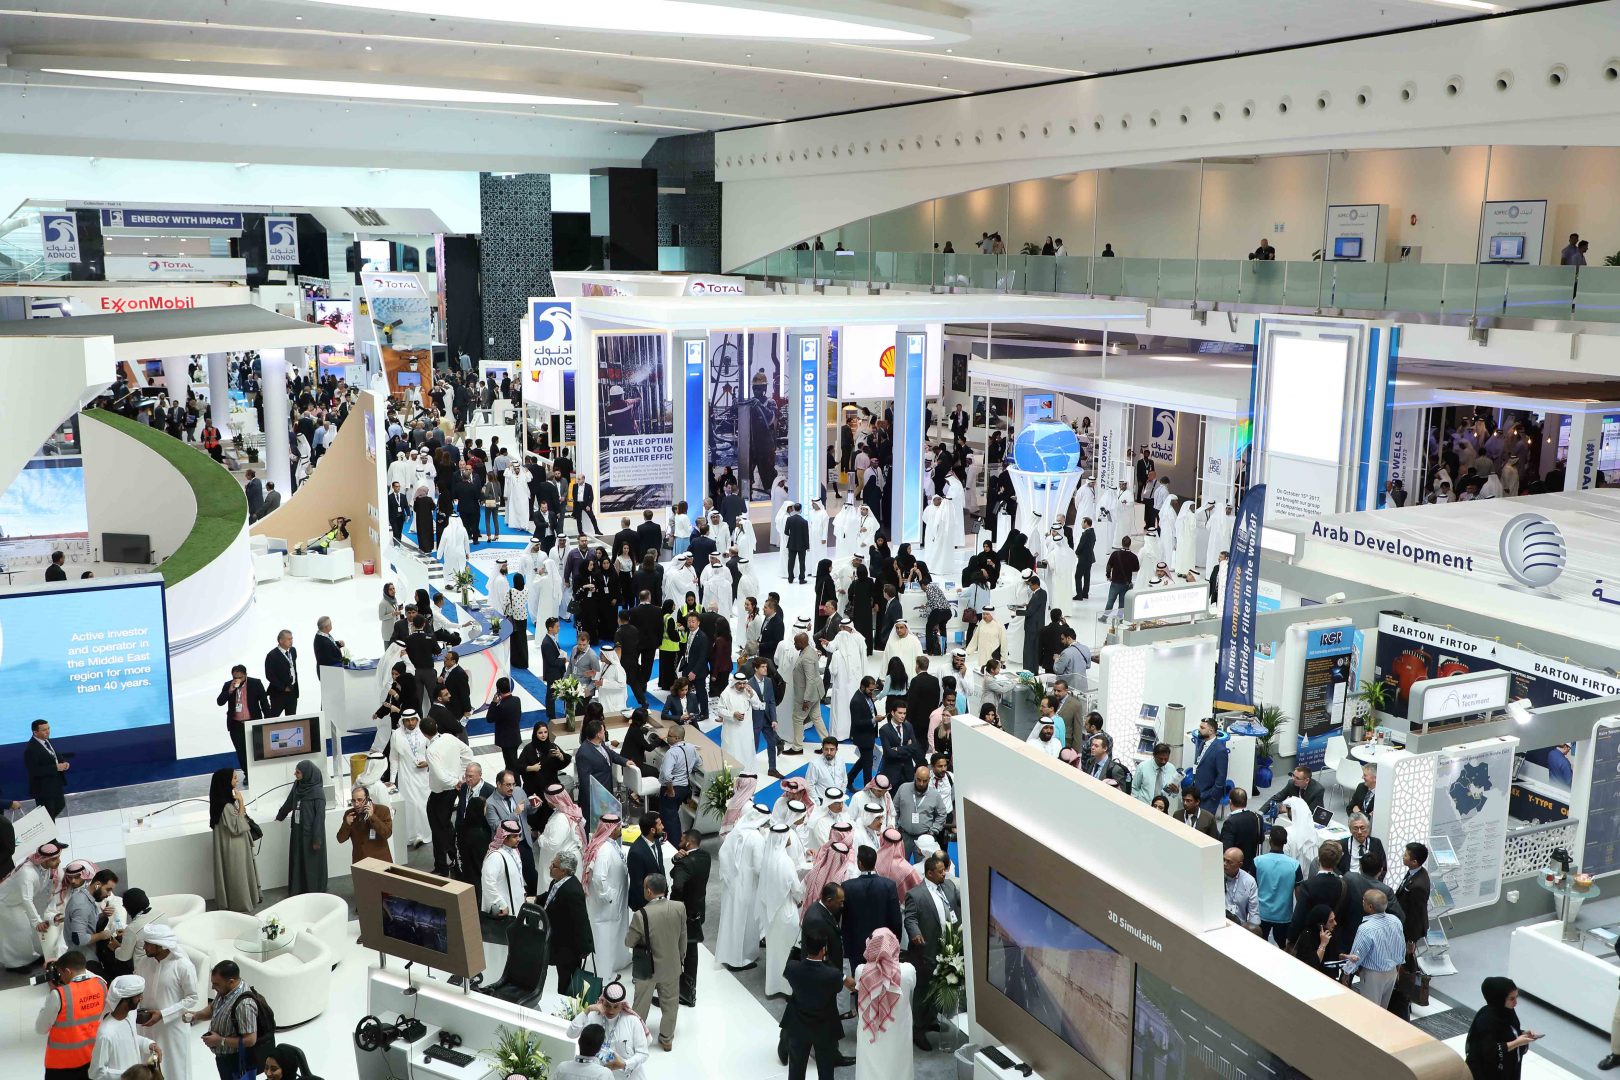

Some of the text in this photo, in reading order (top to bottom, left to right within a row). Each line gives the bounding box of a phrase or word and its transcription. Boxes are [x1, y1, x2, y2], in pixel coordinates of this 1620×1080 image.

[131, 215, 235, 226] ENERGY WITH IMPACT
[101, 296, 195, 313] ExxonMobil
[534, 356, 572, 366] ADNOC
[804, 372, 815, 393] 9.8
[804, 394, 815, 447] BILLION
[612, 437, 673, 447] WE ARE OPTIMI
[612, 446, 651, 455] DRILLING
[1392, 431, 1403, 470] WELLS
[612, 453, 673, 463] GREATER EFFIC
[1100, 435, 1108, 468] LOWER
[1151, 450, 1173, 462] ADNOC
[1312, 521, 1474, 572] Arab Development
[1238, 512, 1258, 695] Cartridge Filter in the world?
[71, 627, 149, 642] Active investor
[1225, 672, 1235, 692] The
[1231, 566, 1242, 638] competitive
[1392, 624, 1478, 652] BARTON FIRTOP
[68, 640, 149, 656] and operator in
[67, 652, 150, 669] the Middle East
[69, 665, 151, 682] region for more
[1534, 663, 1579, 684] BARTON
[77, 679, 152, 694] than 40 years.
[1528, 794, 1553, 810] Y-TYPE
[1107, 910, 1163, 952] 3D Simulation
[79, 992, 101, 1004] ADIPEC
[81, 1001, 100, 1011] MEDIA
